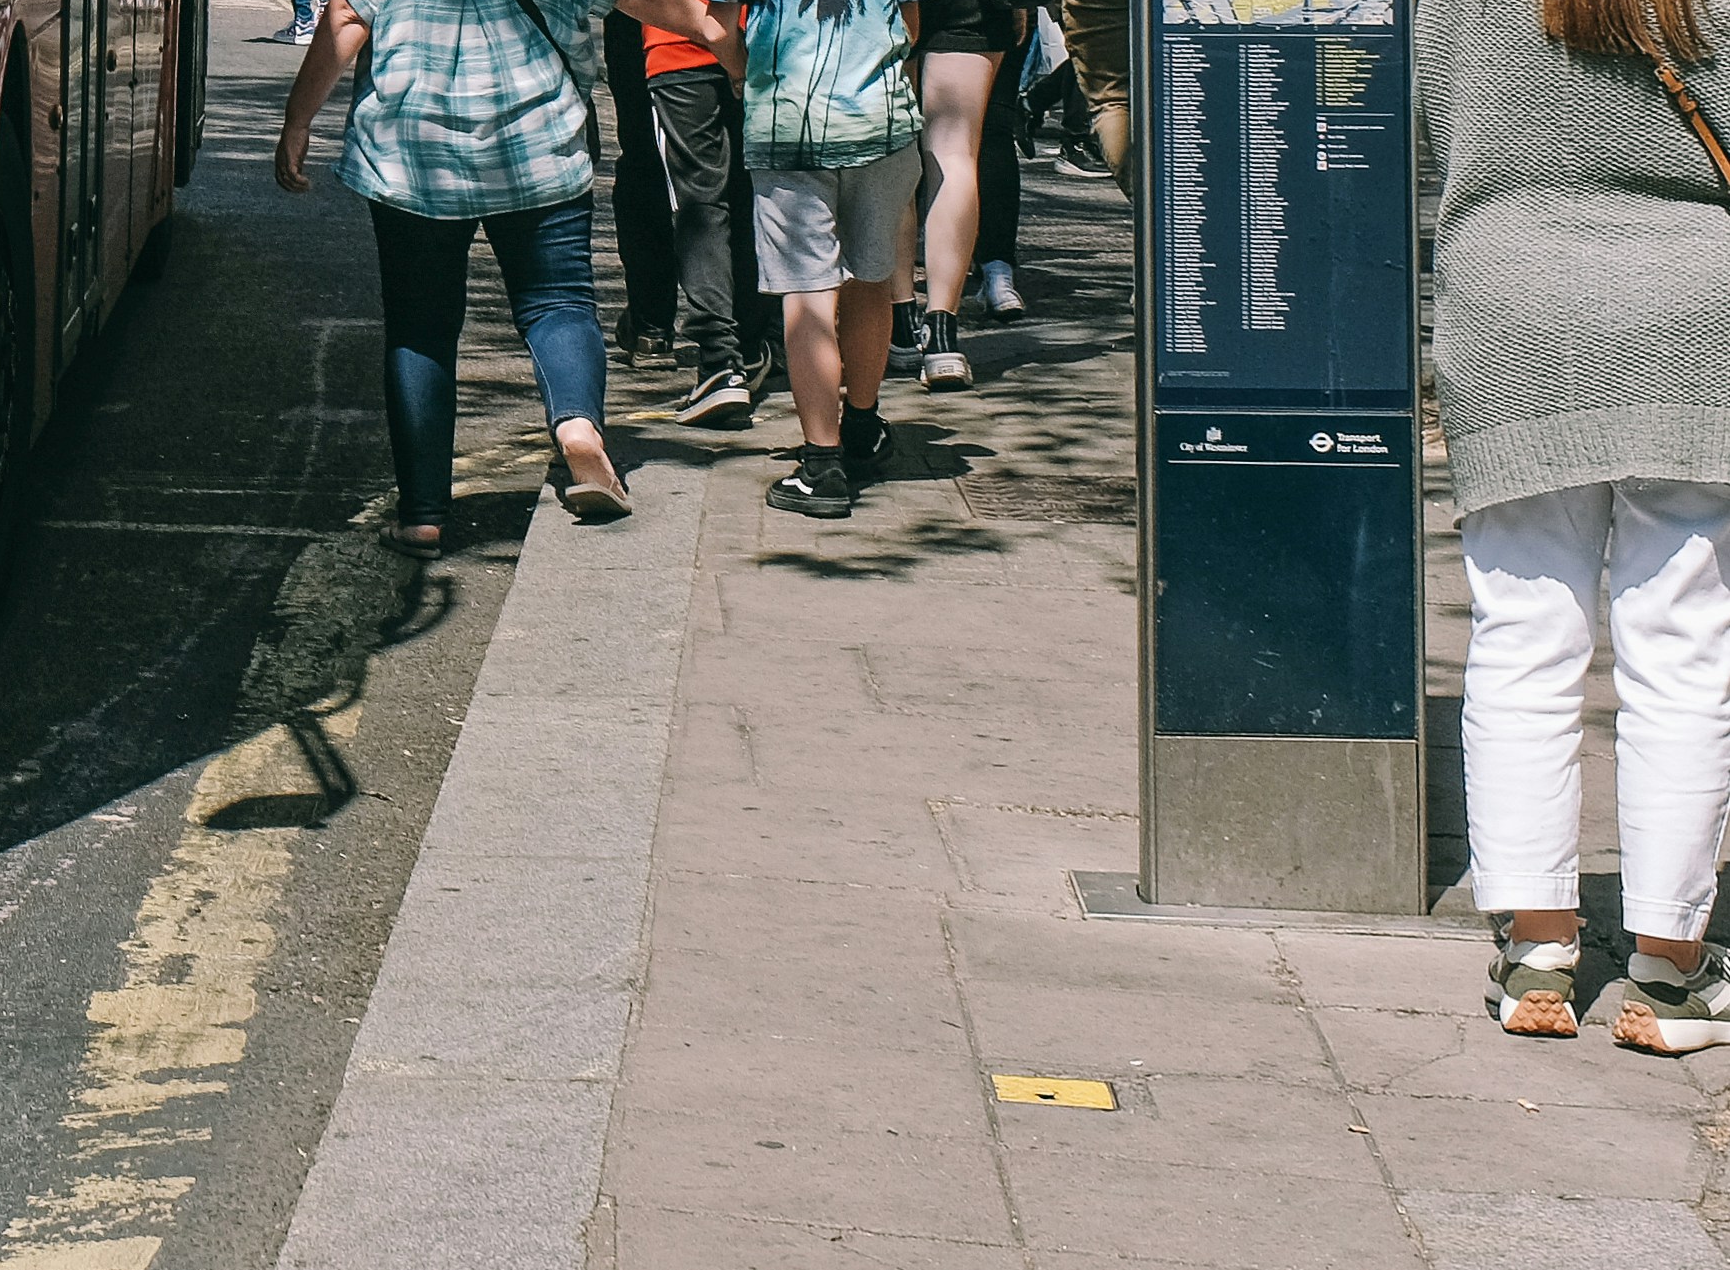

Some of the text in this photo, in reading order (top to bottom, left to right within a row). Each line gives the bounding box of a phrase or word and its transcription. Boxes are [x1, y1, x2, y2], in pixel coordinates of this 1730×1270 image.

[1336, 432, 1382, 443] Transport
[1336, 443, 1389, 454] for London
